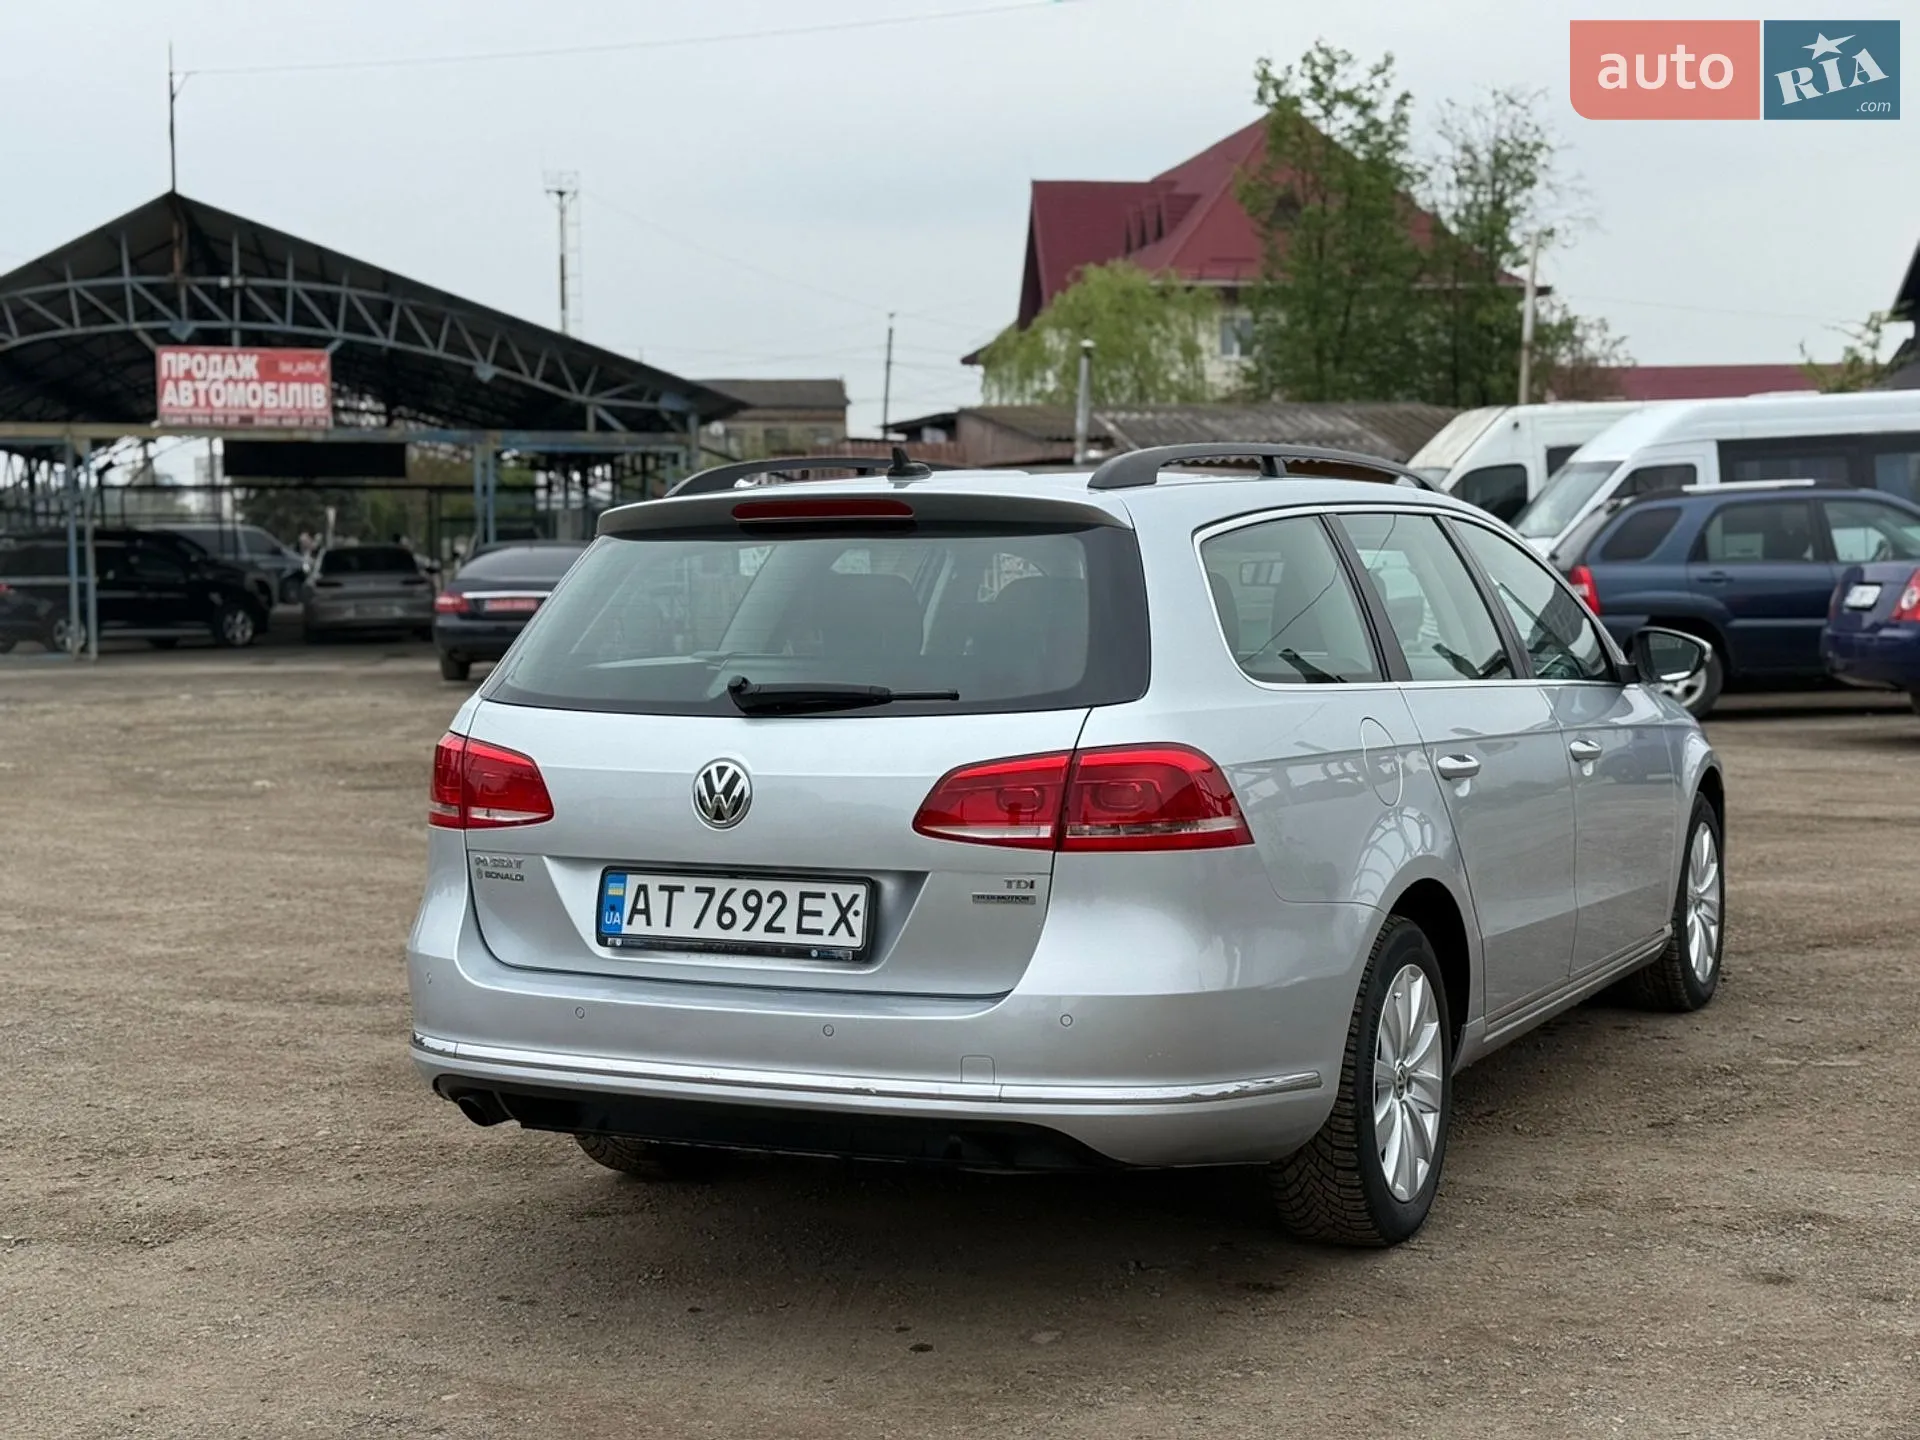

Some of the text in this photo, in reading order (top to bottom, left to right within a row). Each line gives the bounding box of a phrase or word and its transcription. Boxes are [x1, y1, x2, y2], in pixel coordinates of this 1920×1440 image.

[161, 352, 259, 380] ПРОДАЖ
[162, 380, 327, 409] АВТОМОБІЛІВ
[1003, 878, 1035, 889] TDI
[605, 911, 621, 926] UA
[626, 883, 860, 938] AT 7692 EX
